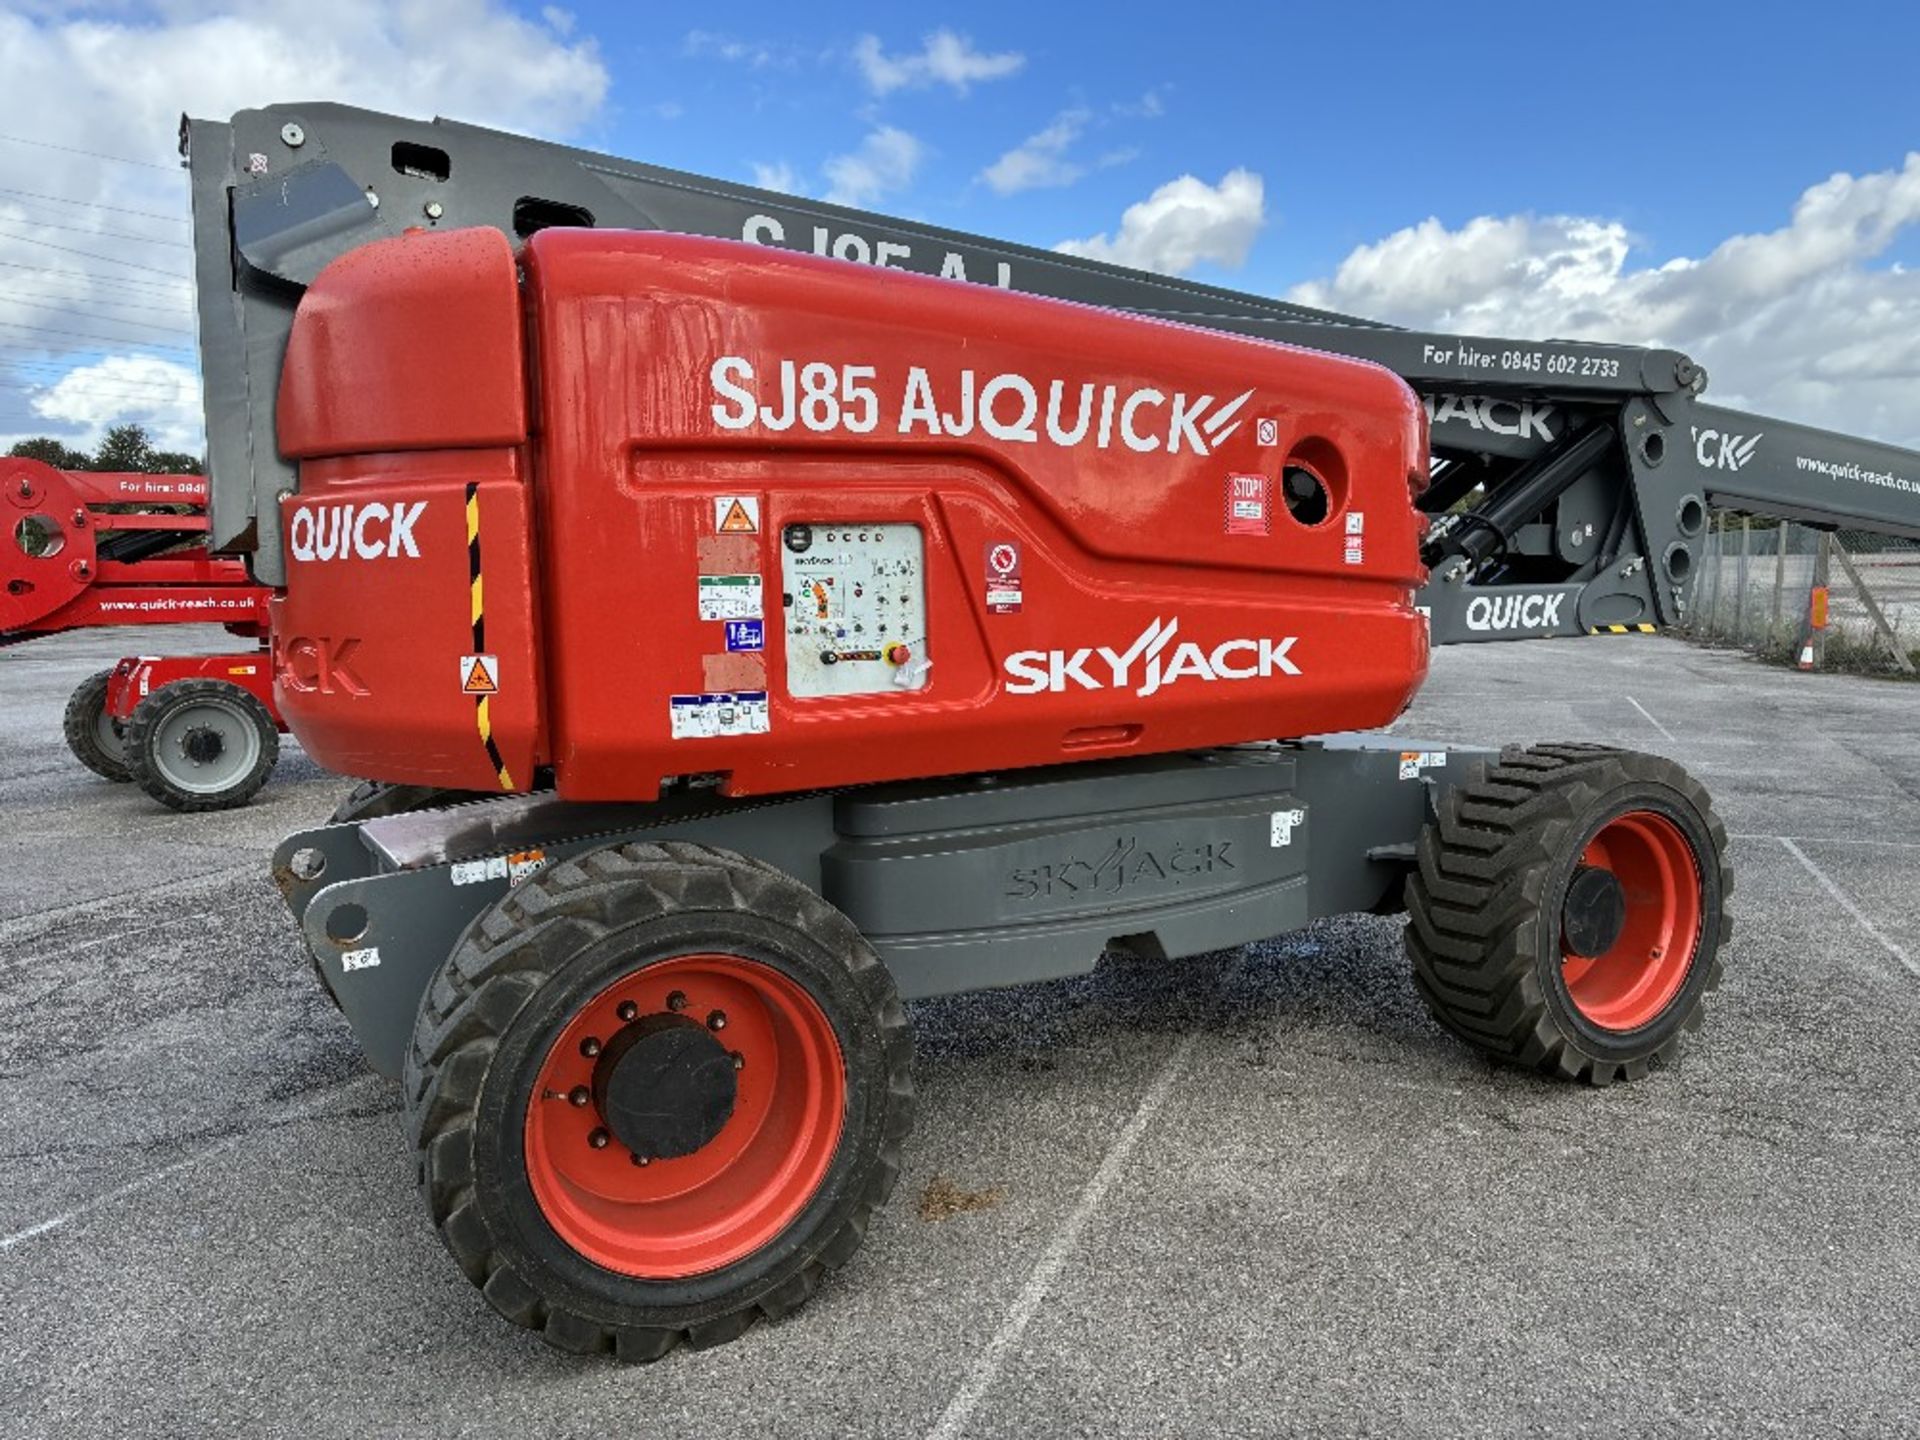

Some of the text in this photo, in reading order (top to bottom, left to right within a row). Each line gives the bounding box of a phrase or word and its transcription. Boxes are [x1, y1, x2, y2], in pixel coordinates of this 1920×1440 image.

[1423, 344, 1620, 377] For hire: 0845 602 2733
[709, 356, 879, 432] SJ85
[120, 481, 141, 493] For
[1233, 477, 1263, 498] STOP!
[1796, 455, 1920, 495] www.quick-reach.co.u
[290, 501, 429, 561] QUICK
[100, 597, 255, 612] www.quick-reach.co.uk
[1465, 592, 1566, 631] QUICK
[1003, 615, 1303, 698] SKYJACK
